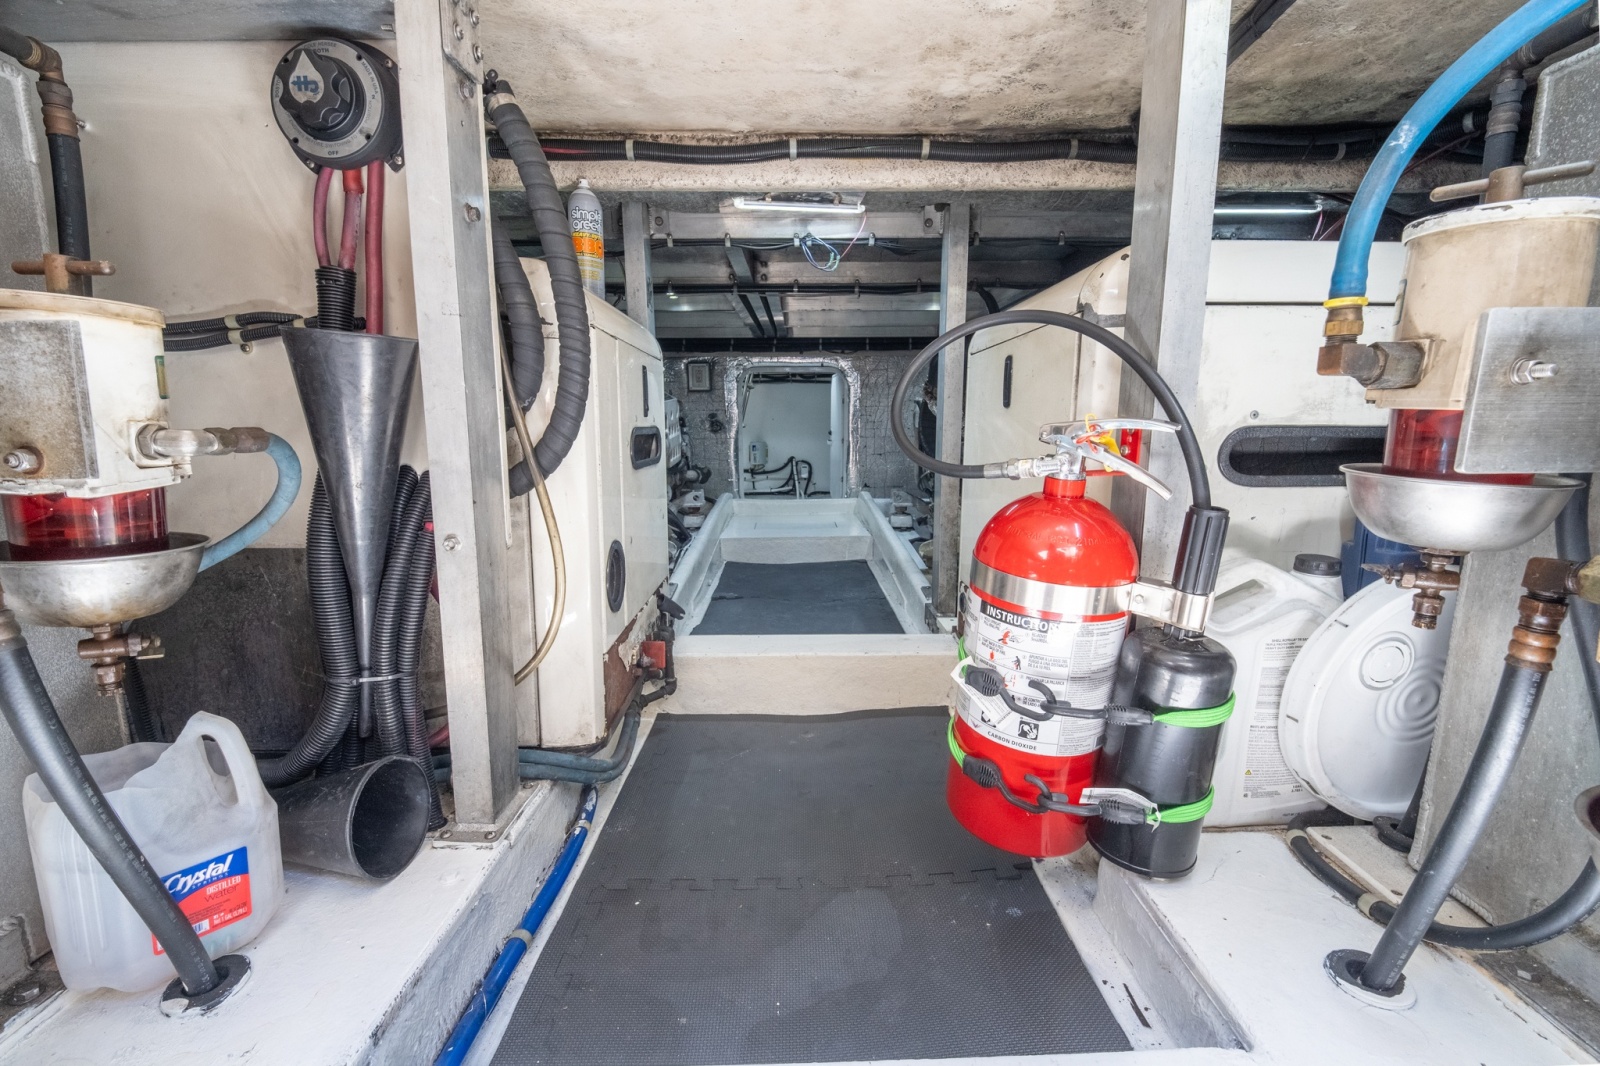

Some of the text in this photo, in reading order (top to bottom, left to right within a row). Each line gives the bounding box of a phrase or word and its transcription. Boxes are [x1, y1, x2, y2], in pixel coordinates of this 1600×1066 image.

[987, 731, 1037, 751] CARBON DIOXIDE
[164, 854, 234, 894] Crystal
[192, 872, 229, 889] SPRINGS
[204, 884, 239, 902] water
[206, 876, 241, 895] DISTILLED
